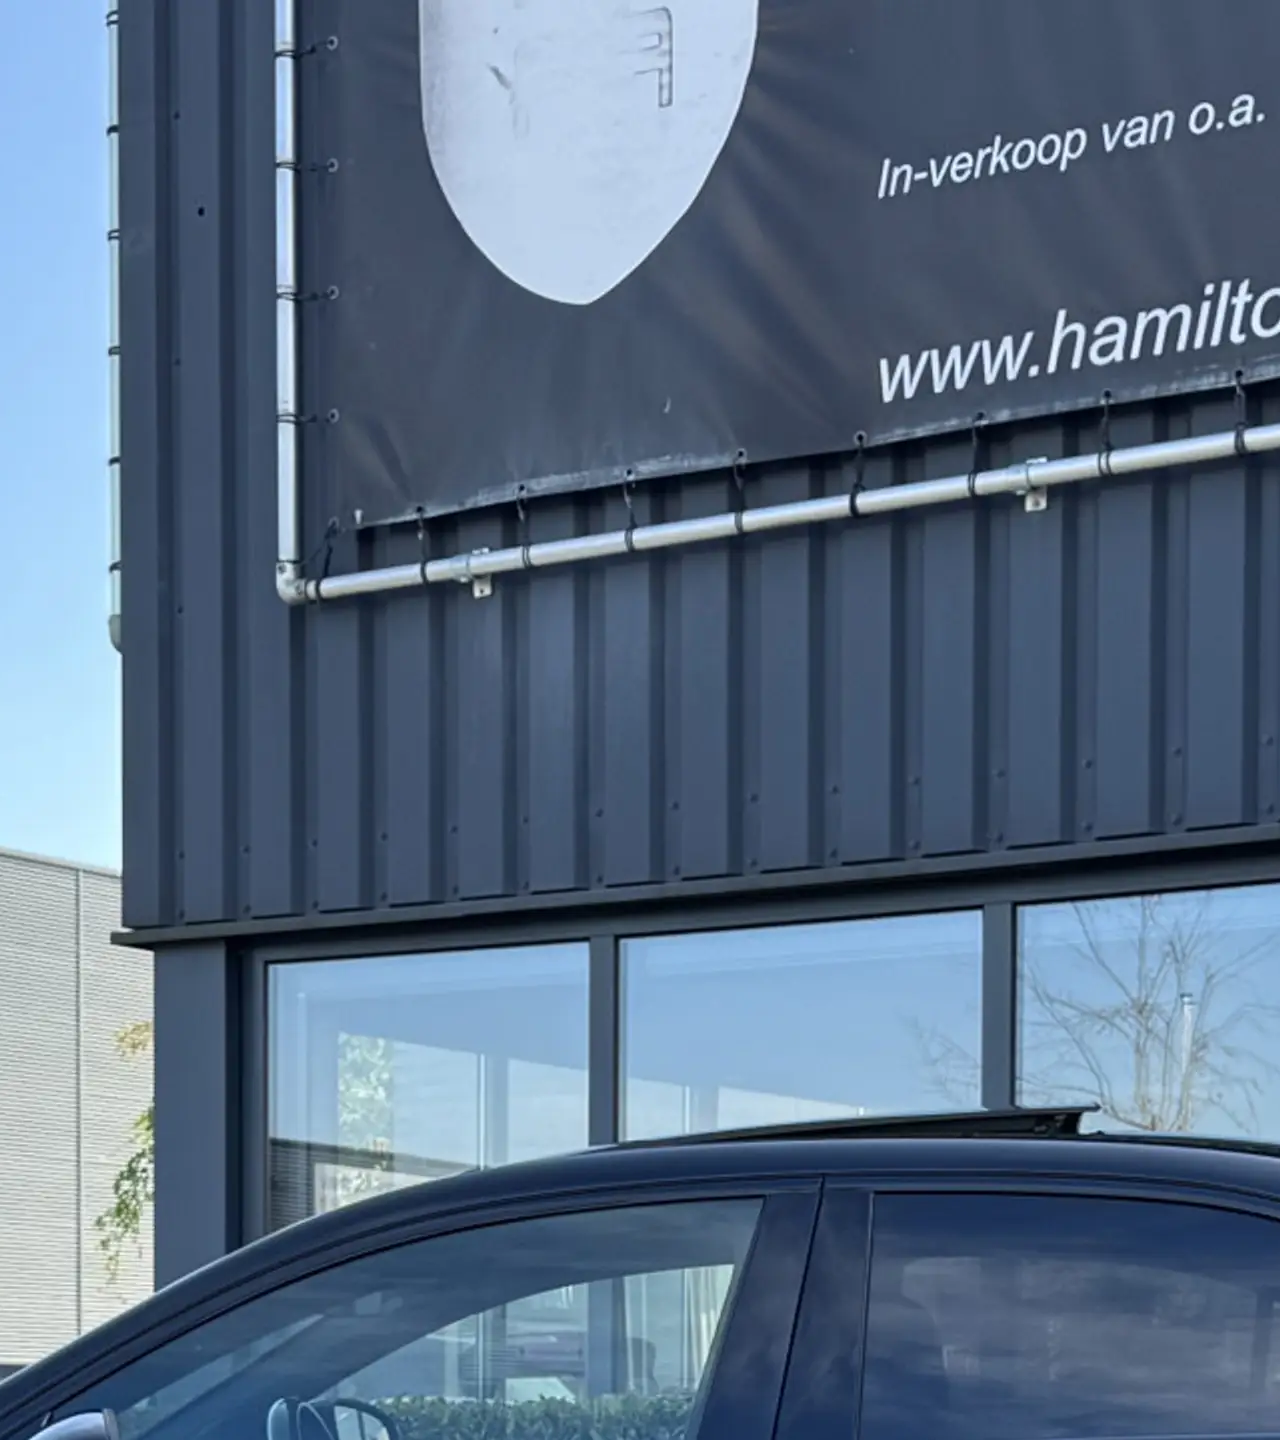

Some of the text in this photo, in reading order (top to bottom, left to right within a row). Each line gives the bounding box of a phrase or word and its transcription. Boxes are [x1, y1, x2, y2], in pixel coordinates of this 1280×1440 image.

[877, 126, 1088, 199] In-verkoop
[1102, 108, 1176, 153] van
[1187, 93, 1266, 136] o.a.
